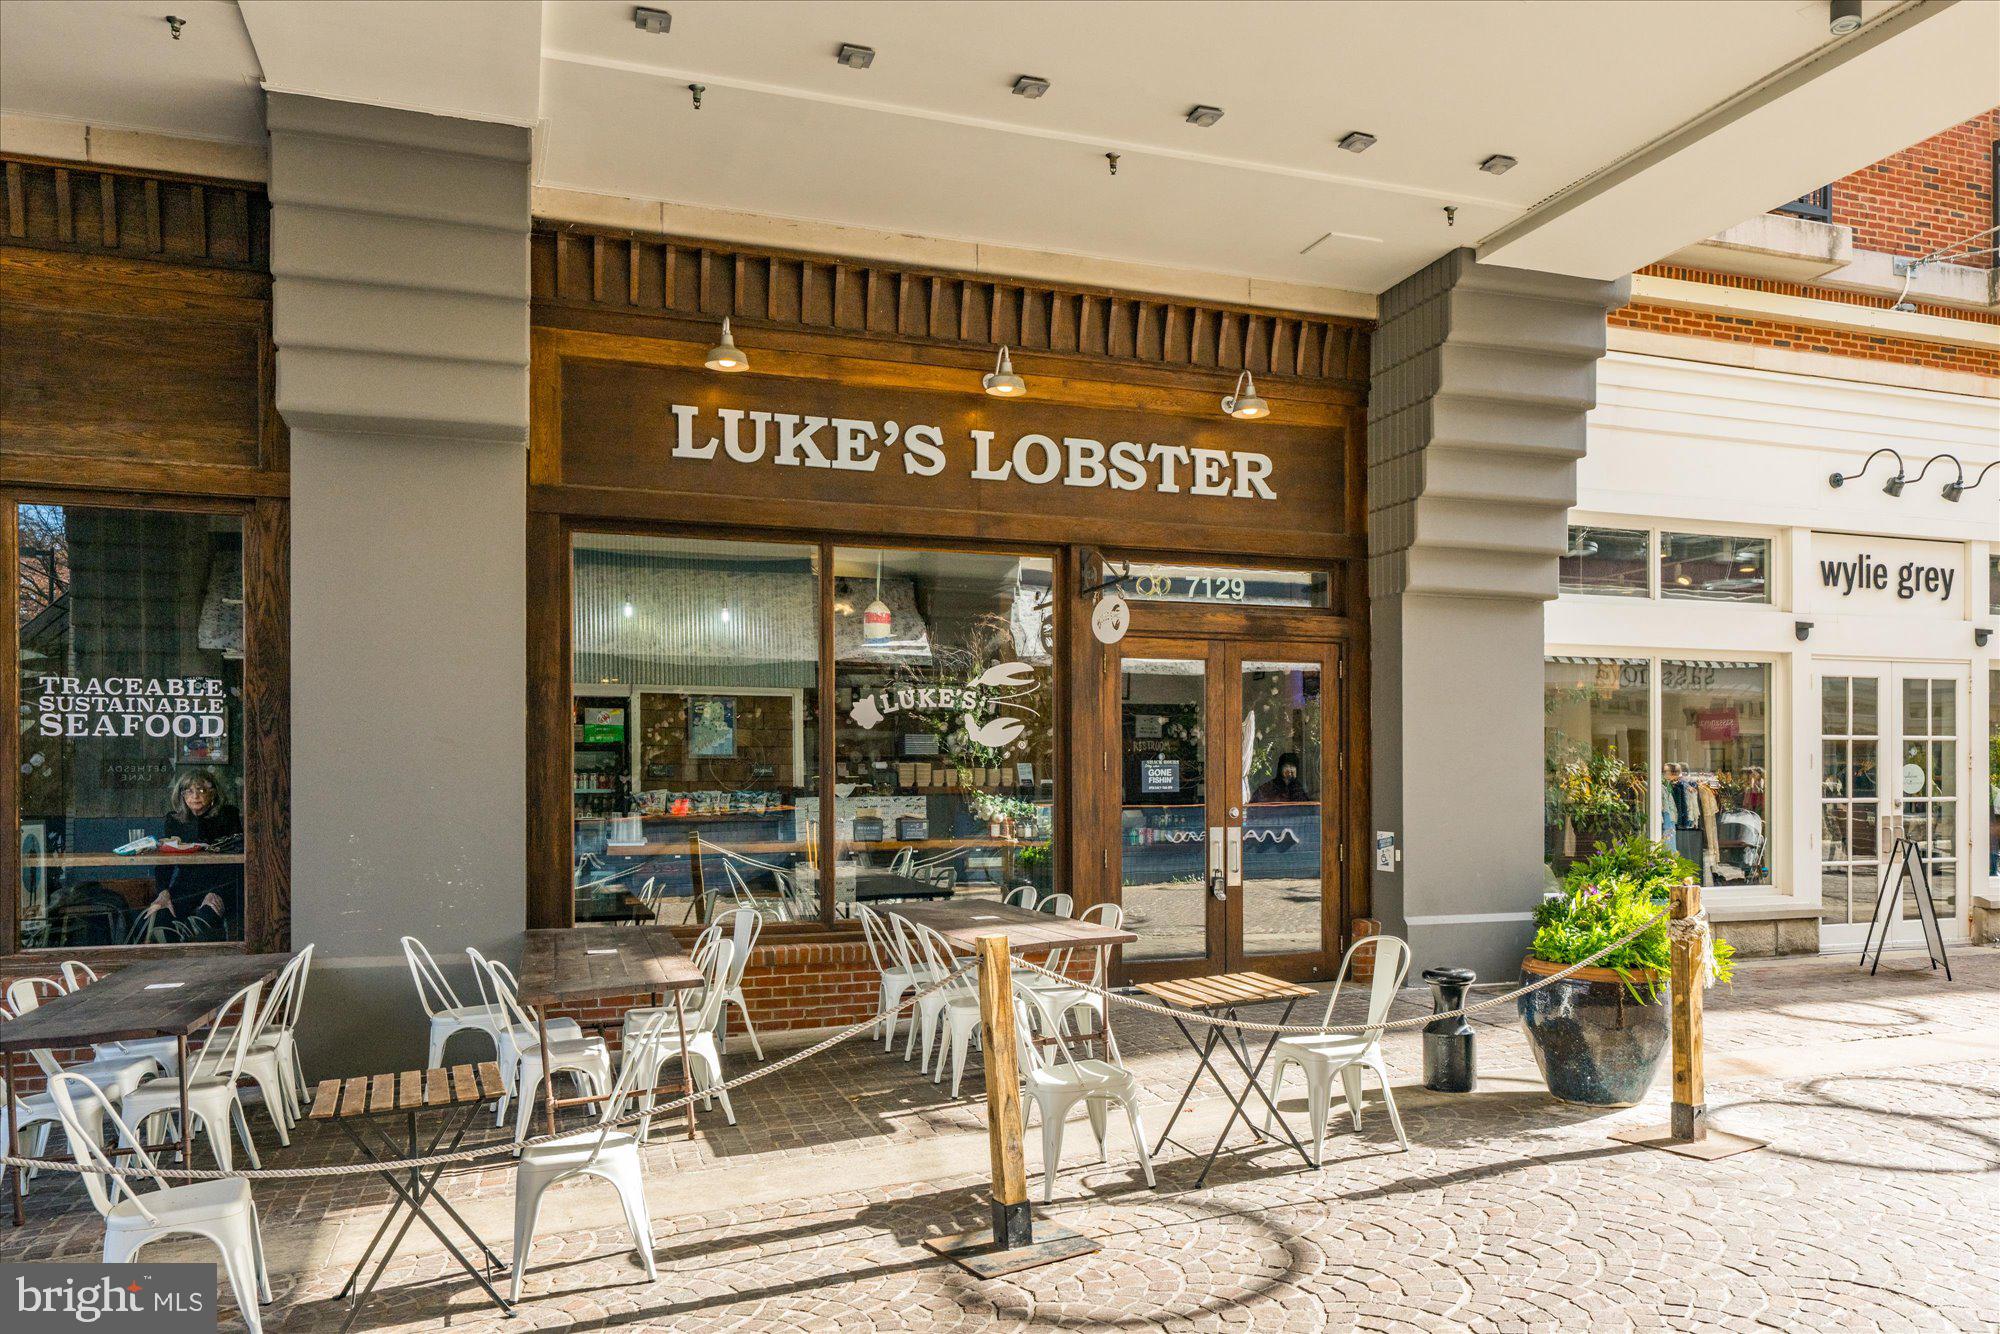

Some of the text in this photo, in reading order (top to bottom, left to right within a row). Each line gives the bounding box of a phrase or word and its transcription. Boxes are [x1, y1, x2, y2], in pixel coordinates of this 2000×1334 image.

[672, 404, 1278, 500] LUKE'S LOBSTER
[1185, 575, 1246, 601] 7129
[1820, 554, 1955, 600] wylie grey
[39, 676, 227, 698] TRACEABLE,
[39, 696, 224, 714] SUSTAINABLE
[880, 688, 977, 714] LUKE'S
[39, 713, 228, 738] SEAFOOD.
[1148, 768, 1172, 777] GONE
